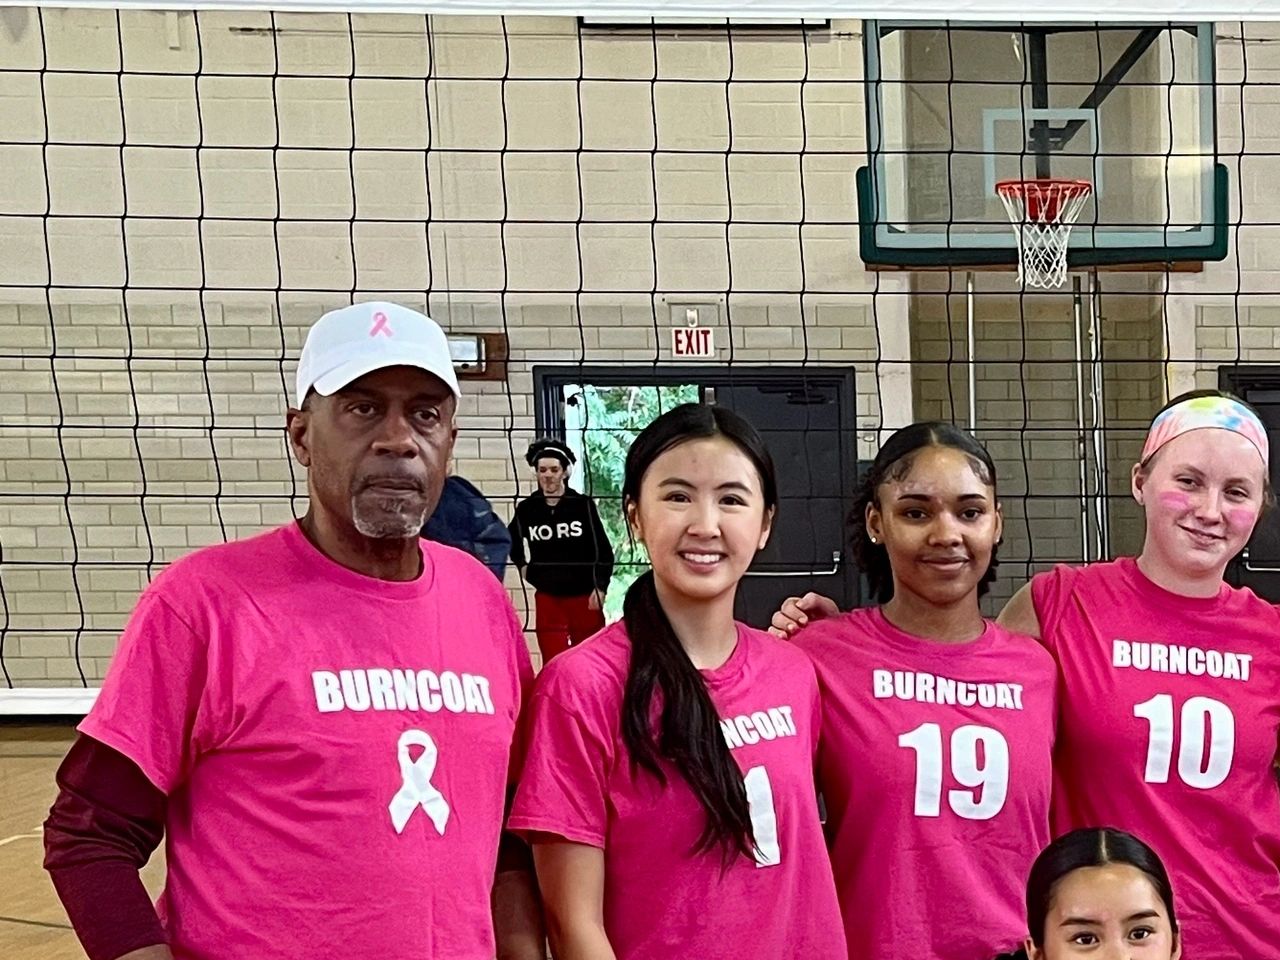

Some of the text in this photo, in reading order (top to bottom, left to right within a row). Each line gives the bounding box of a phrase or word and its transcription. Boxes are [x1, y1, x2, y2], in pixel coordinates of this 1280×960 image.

[674, 329, 711, 355] EXIT
[528, 520, 583, 541] KORS
[1112, 639, 1253, 682] BURNCOAT
[312, 668, 496, 714] BURNCOAT
[873, 669, 1024, 711] BURNCOAT
[719, 705, 798, 749] NCOAT
[1133, 693, 1236, 790] 10
[898, 722, 1010, 820] 19
[743, 765, 781, 868] 1
